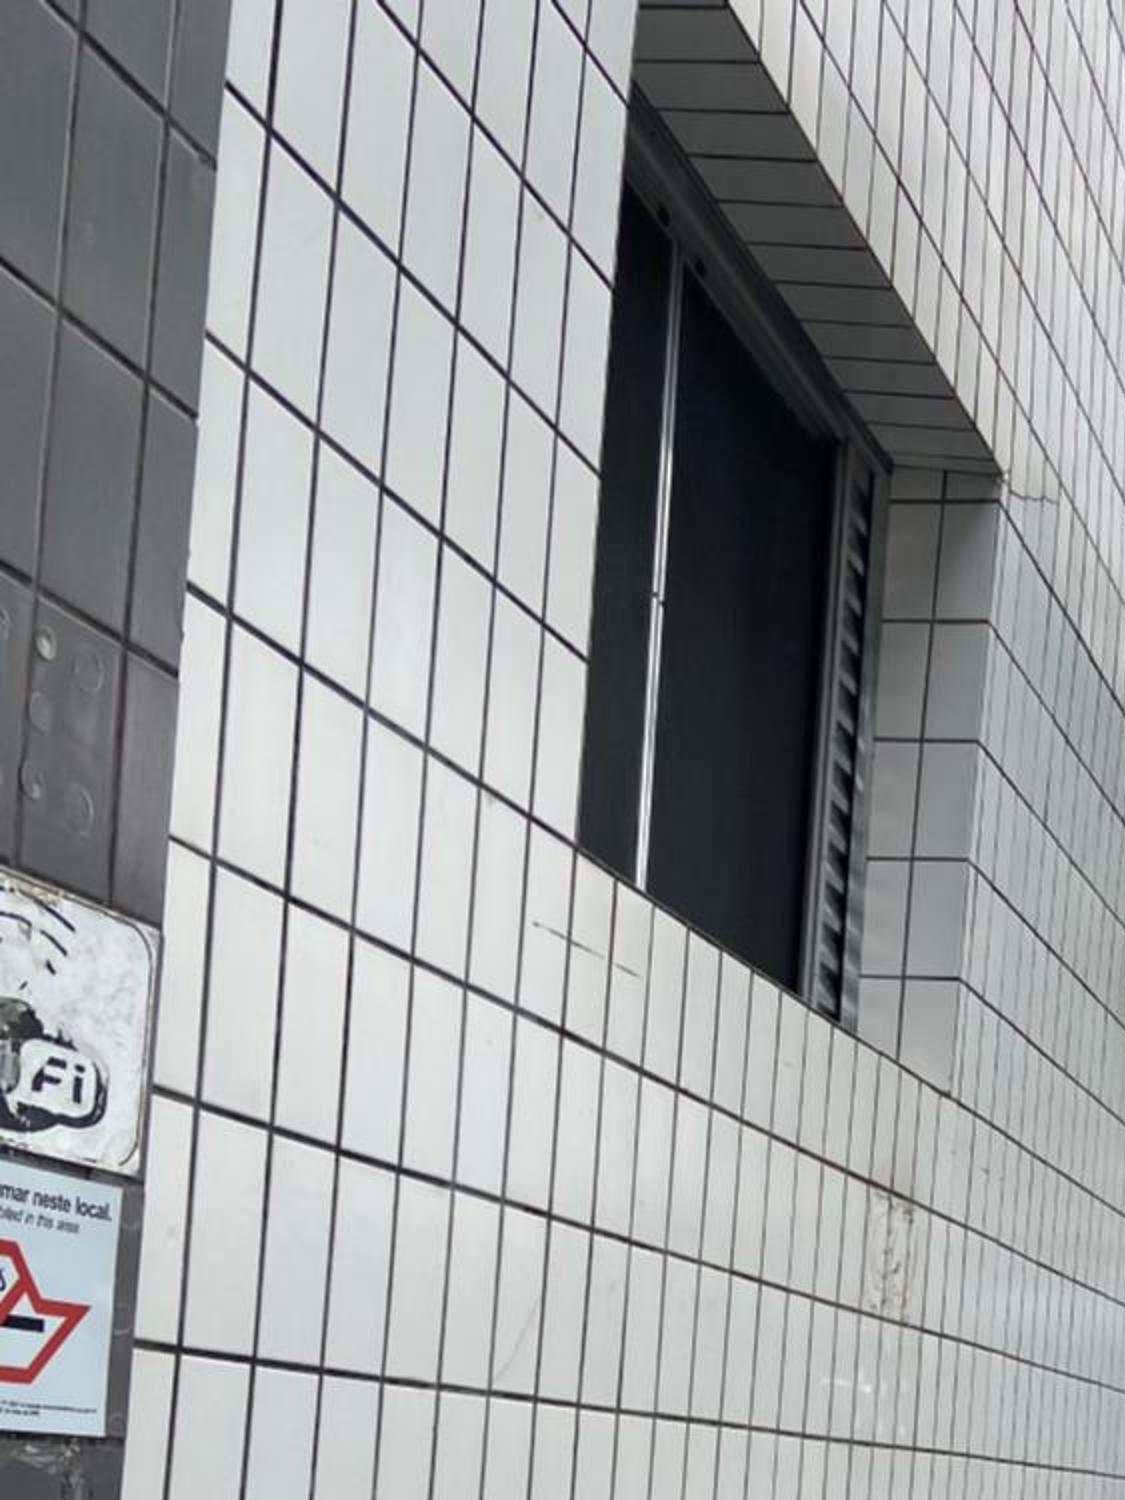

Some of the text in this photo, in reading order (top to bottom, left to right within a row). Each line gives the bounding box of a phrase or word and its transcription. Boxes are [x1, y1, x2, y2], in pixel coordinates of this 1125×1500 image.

[32, 1056, 85, 1104] Fi
[33, 1191, 71, 1213] neste
[76, 1196, 112, 1221] local.
